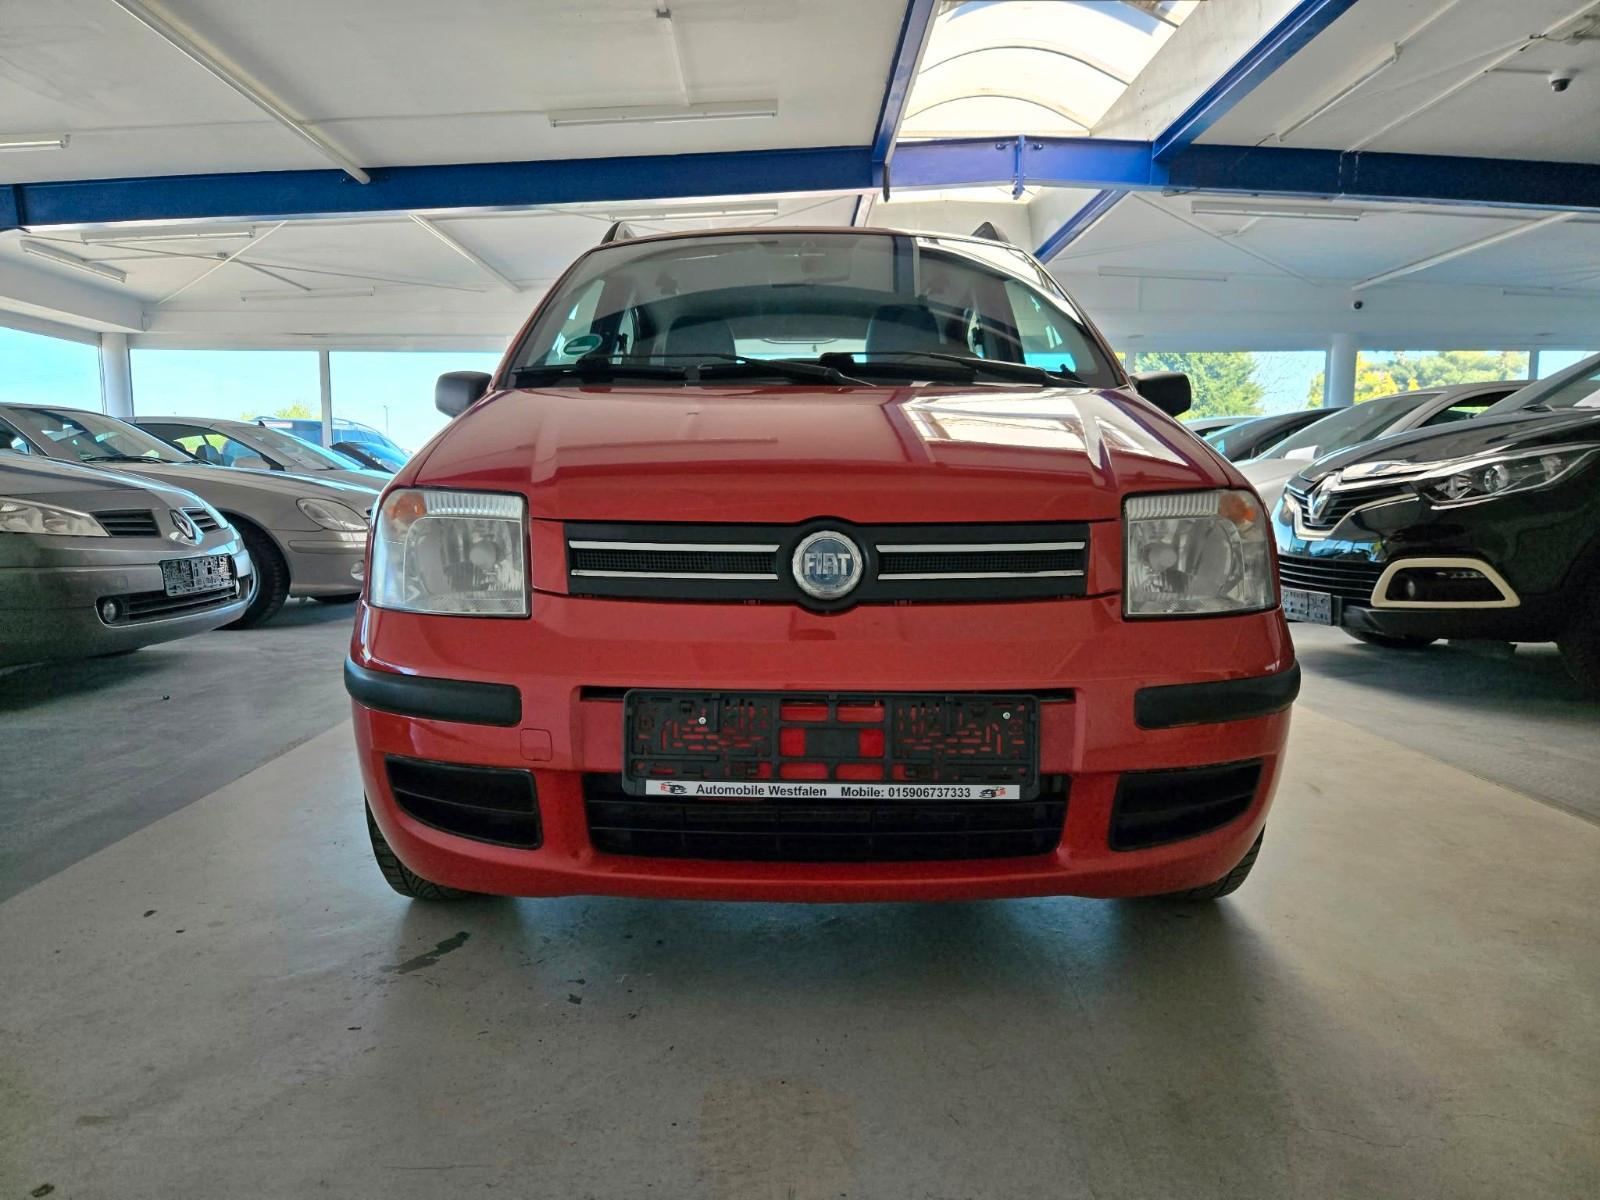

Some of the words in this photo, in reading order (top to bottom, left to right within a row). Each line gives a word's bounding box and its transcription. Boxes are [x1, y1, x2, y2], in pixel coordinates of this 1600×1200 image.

[804, 552, 851, 575] FIAT
[696, 784, 764, 795] Automobile
[768, 785, 827, 797] Westfalen
[841, 786, 884, 798] Mobile:
[888, 787, 971, 798] 015906737333
